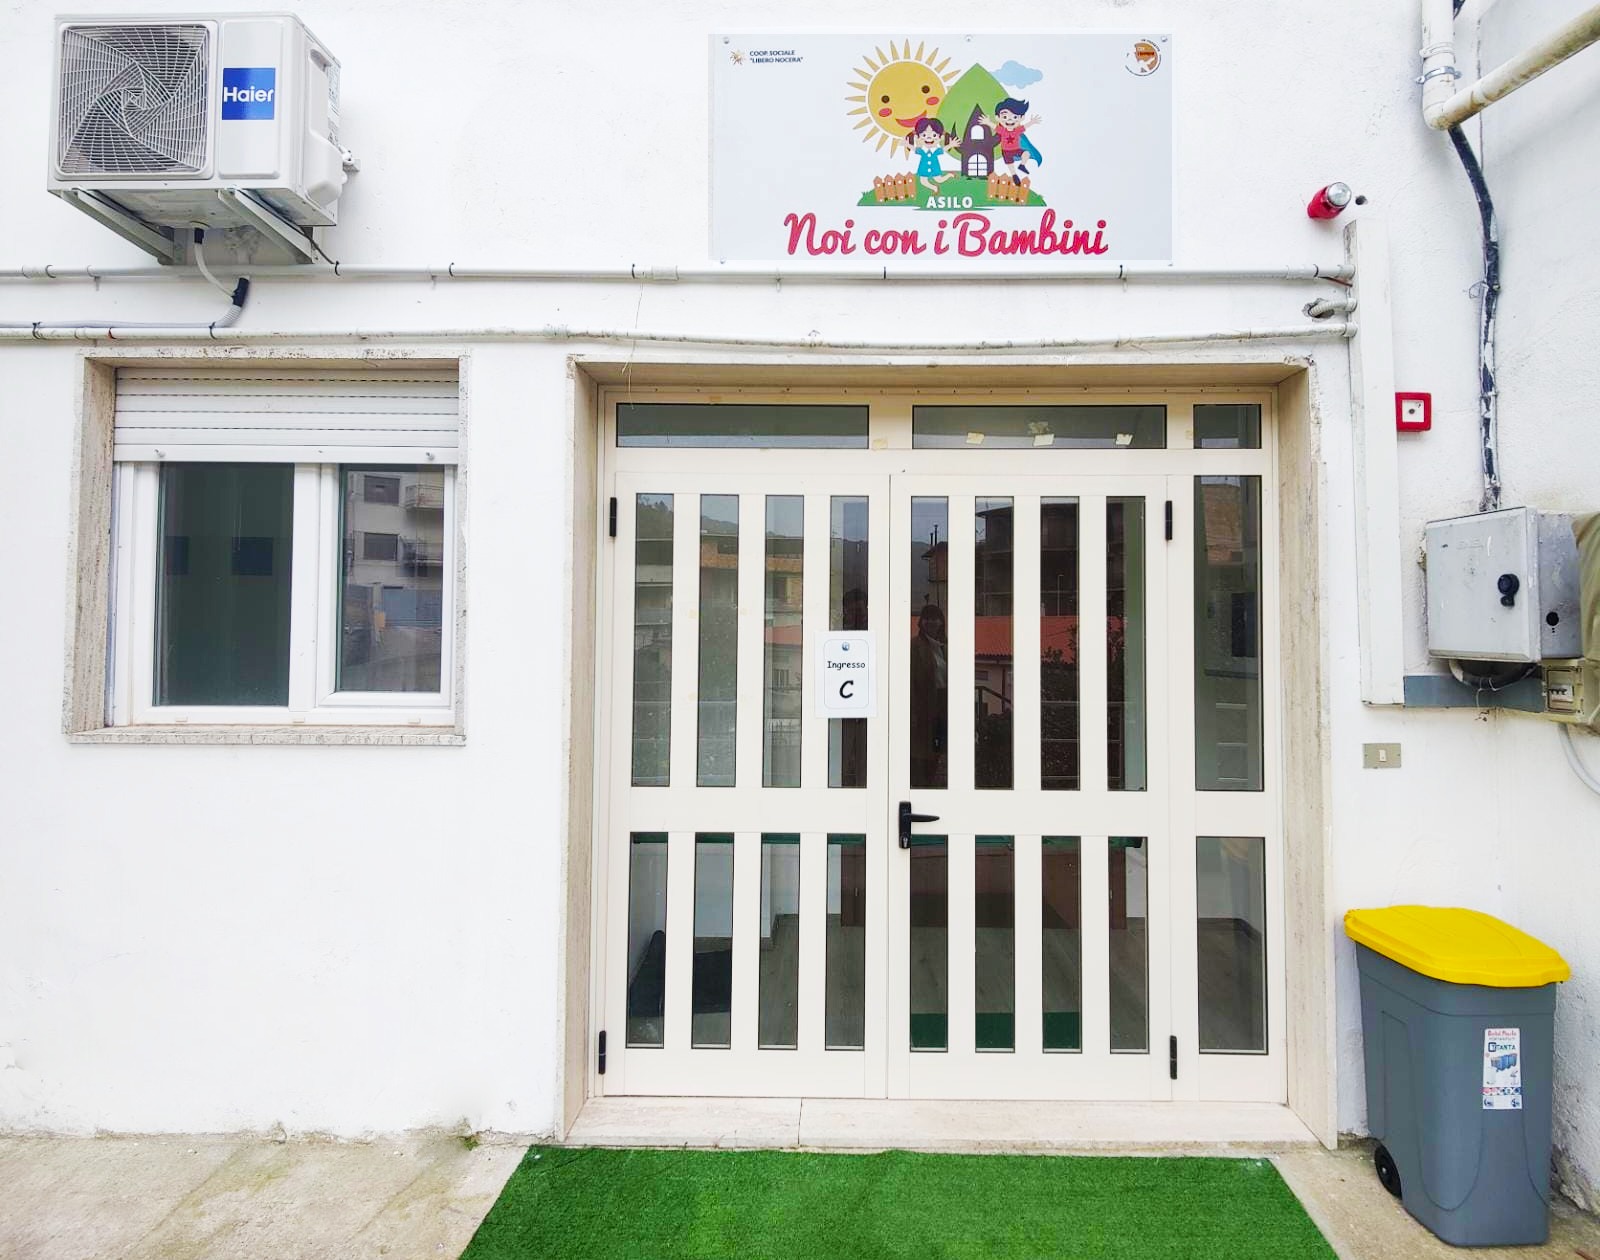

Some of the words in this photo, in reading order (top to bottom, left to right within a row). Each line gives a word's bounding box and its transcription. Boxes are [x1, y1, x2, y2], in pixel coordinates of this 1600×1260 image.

[223, 85, 274, 103] Haier
[926, 196, 973, 209] ASILO
[783, 212, 856, 256] Noi
[864, 229, 927, 255] con
[934, 219, 950, 255] i
[953, 208, 1109, 257] Bambini
[827, 660, 866, 671] Ingresso
[839, 680, 854, 699] C
